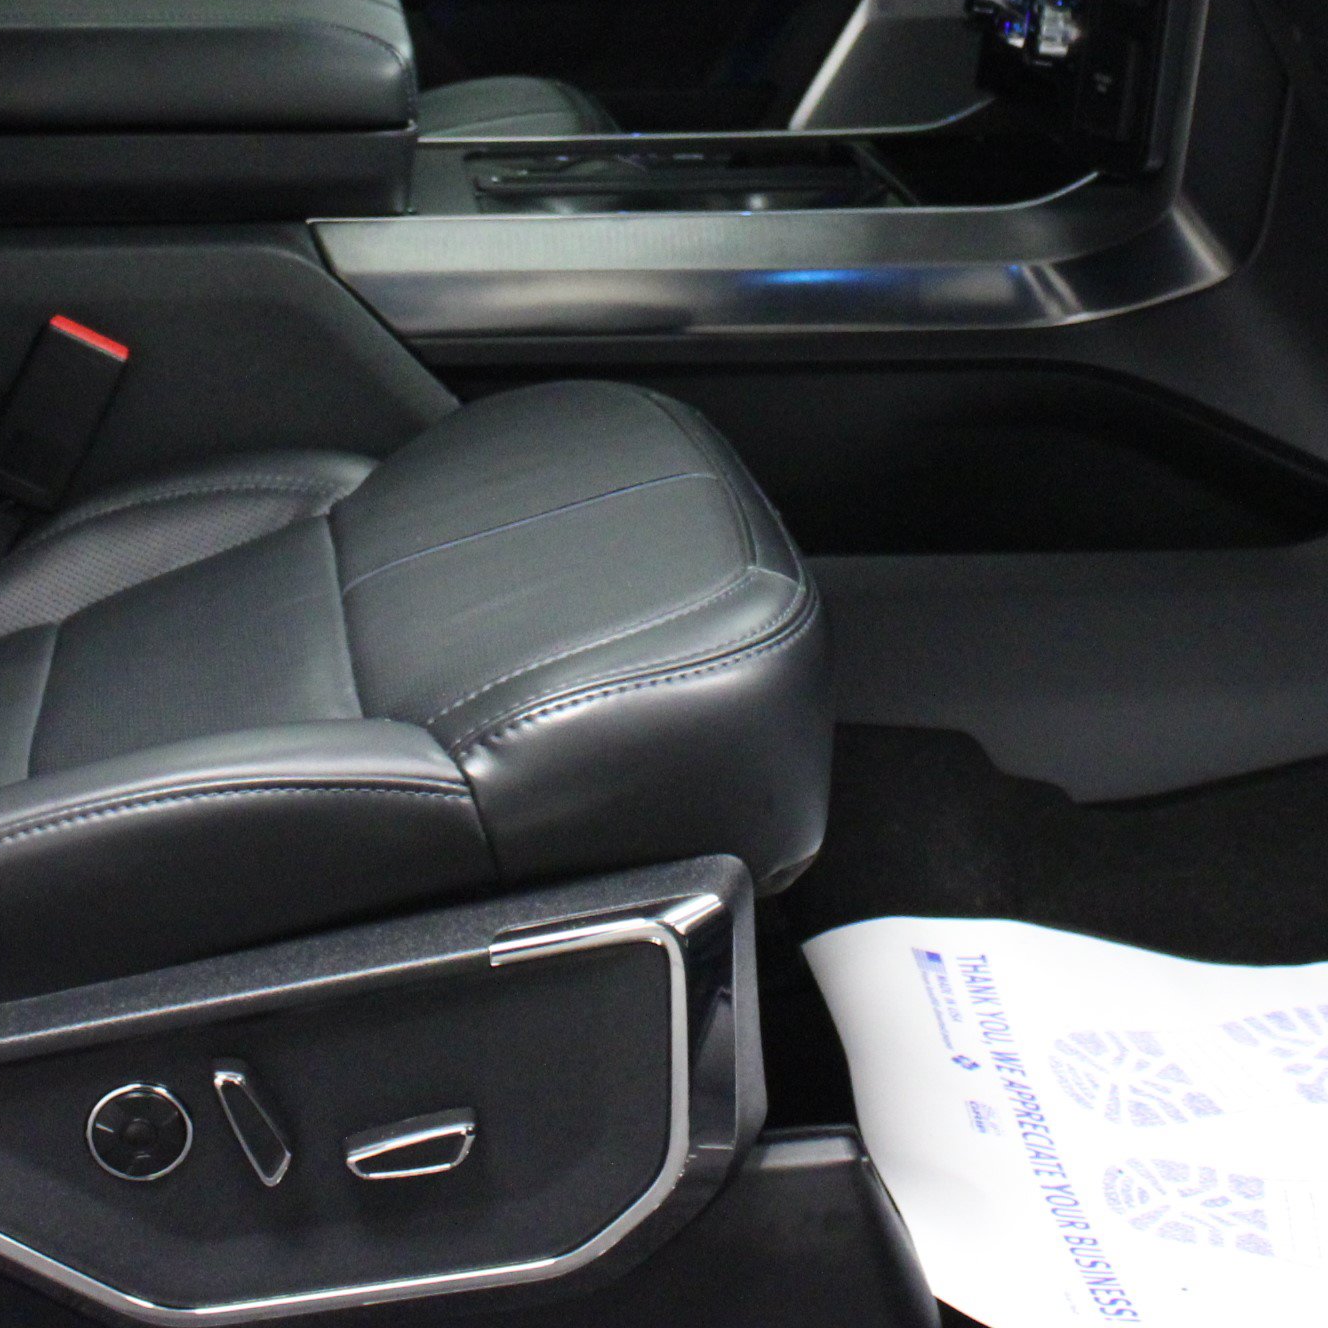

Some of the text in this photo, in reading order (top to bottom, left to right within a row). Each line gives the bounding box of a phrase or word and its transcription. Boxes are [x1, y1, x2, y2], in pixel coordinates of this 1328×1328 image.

[956, 954, 1002, 1006] THANK
[976, 1011, 1015, 1045] YOU,
[990, 1050, 1027, 1078] WE
[1000, 1076, 1068, 1179] APPRECIATE
[1040, 1184, 1091, 1230] YOUR
[1063, 1235, 1142, 1323] BUSINESS!
